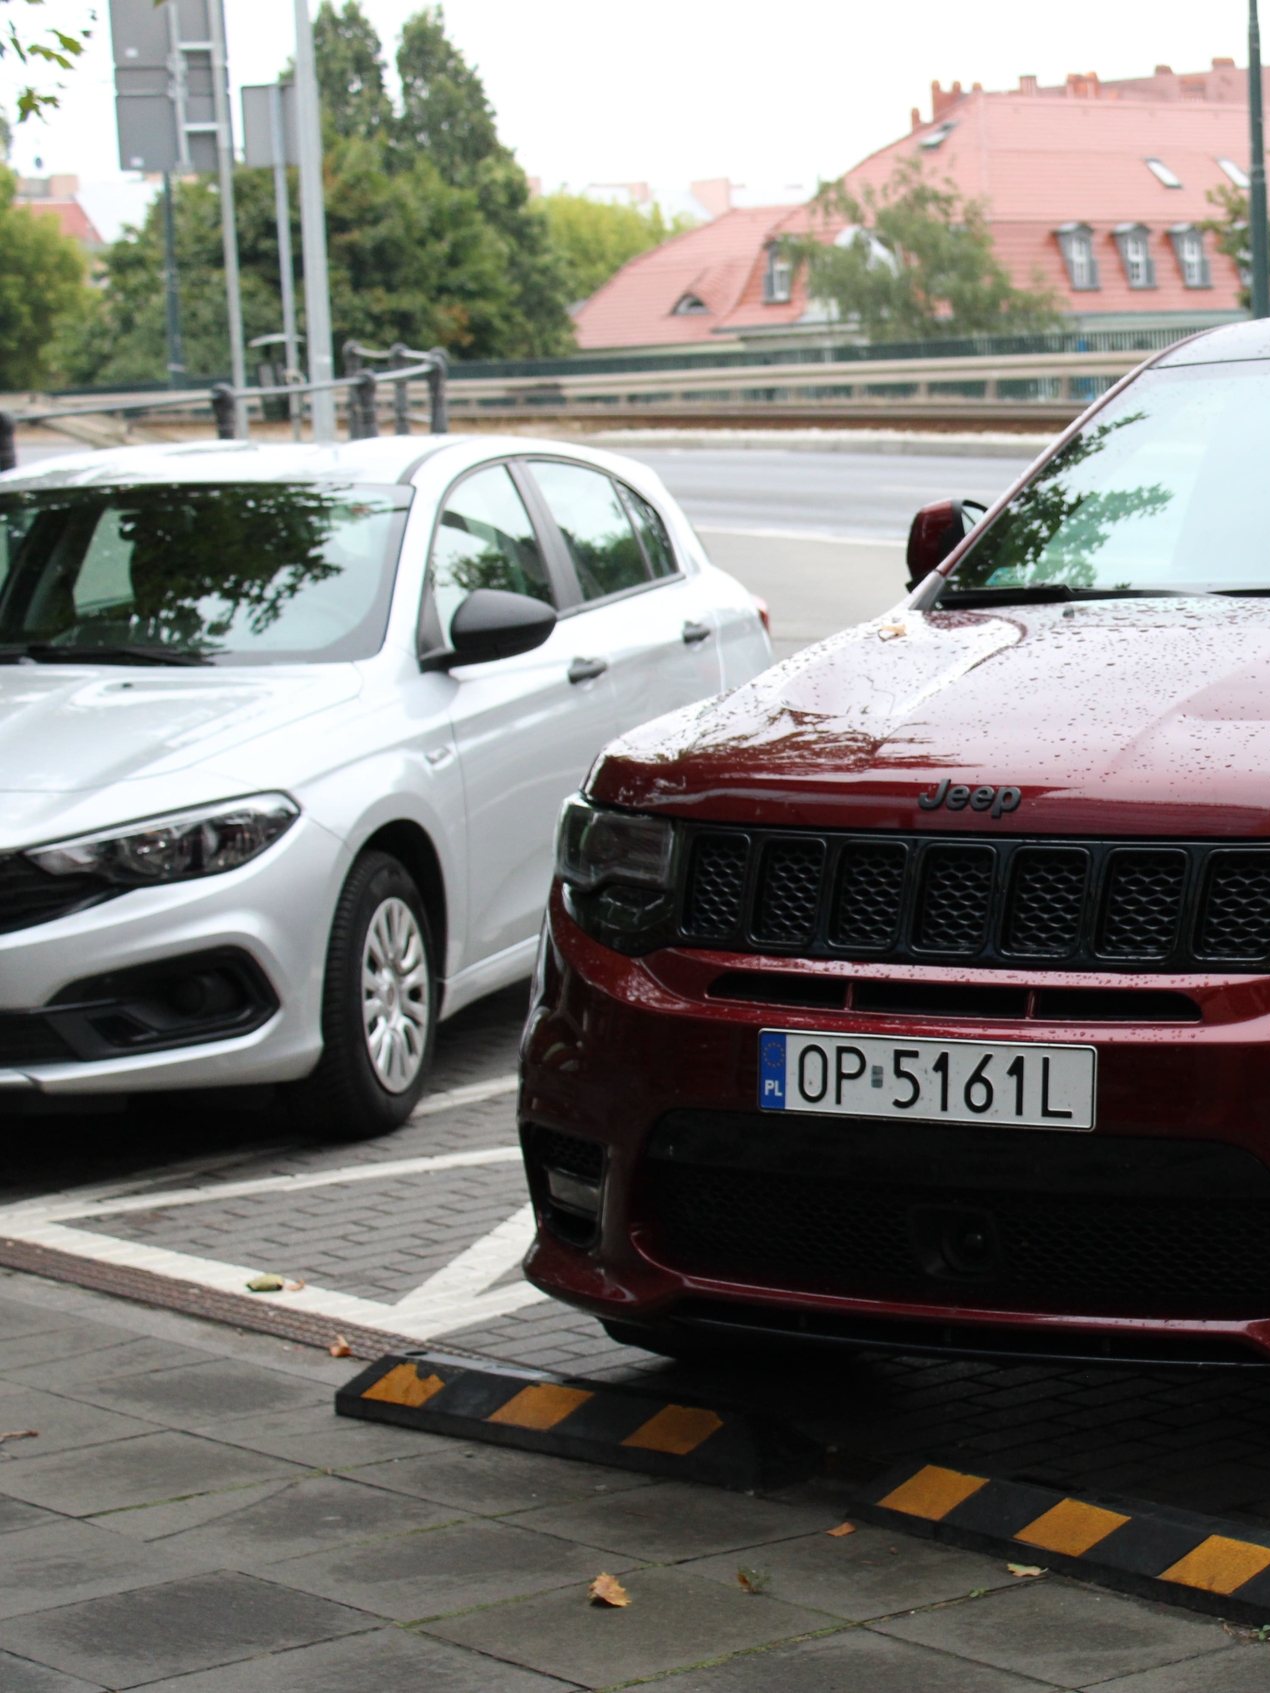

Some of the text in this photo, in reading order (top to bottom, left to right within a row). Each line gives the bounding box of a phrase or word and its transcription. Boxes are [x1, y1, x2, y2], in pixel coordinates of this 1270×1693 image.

[918, 778, 1022, 819] Jeep
[764, 1079, 782, 1097] PL
[798, 1044, 1073, 1119] OP 5161L
